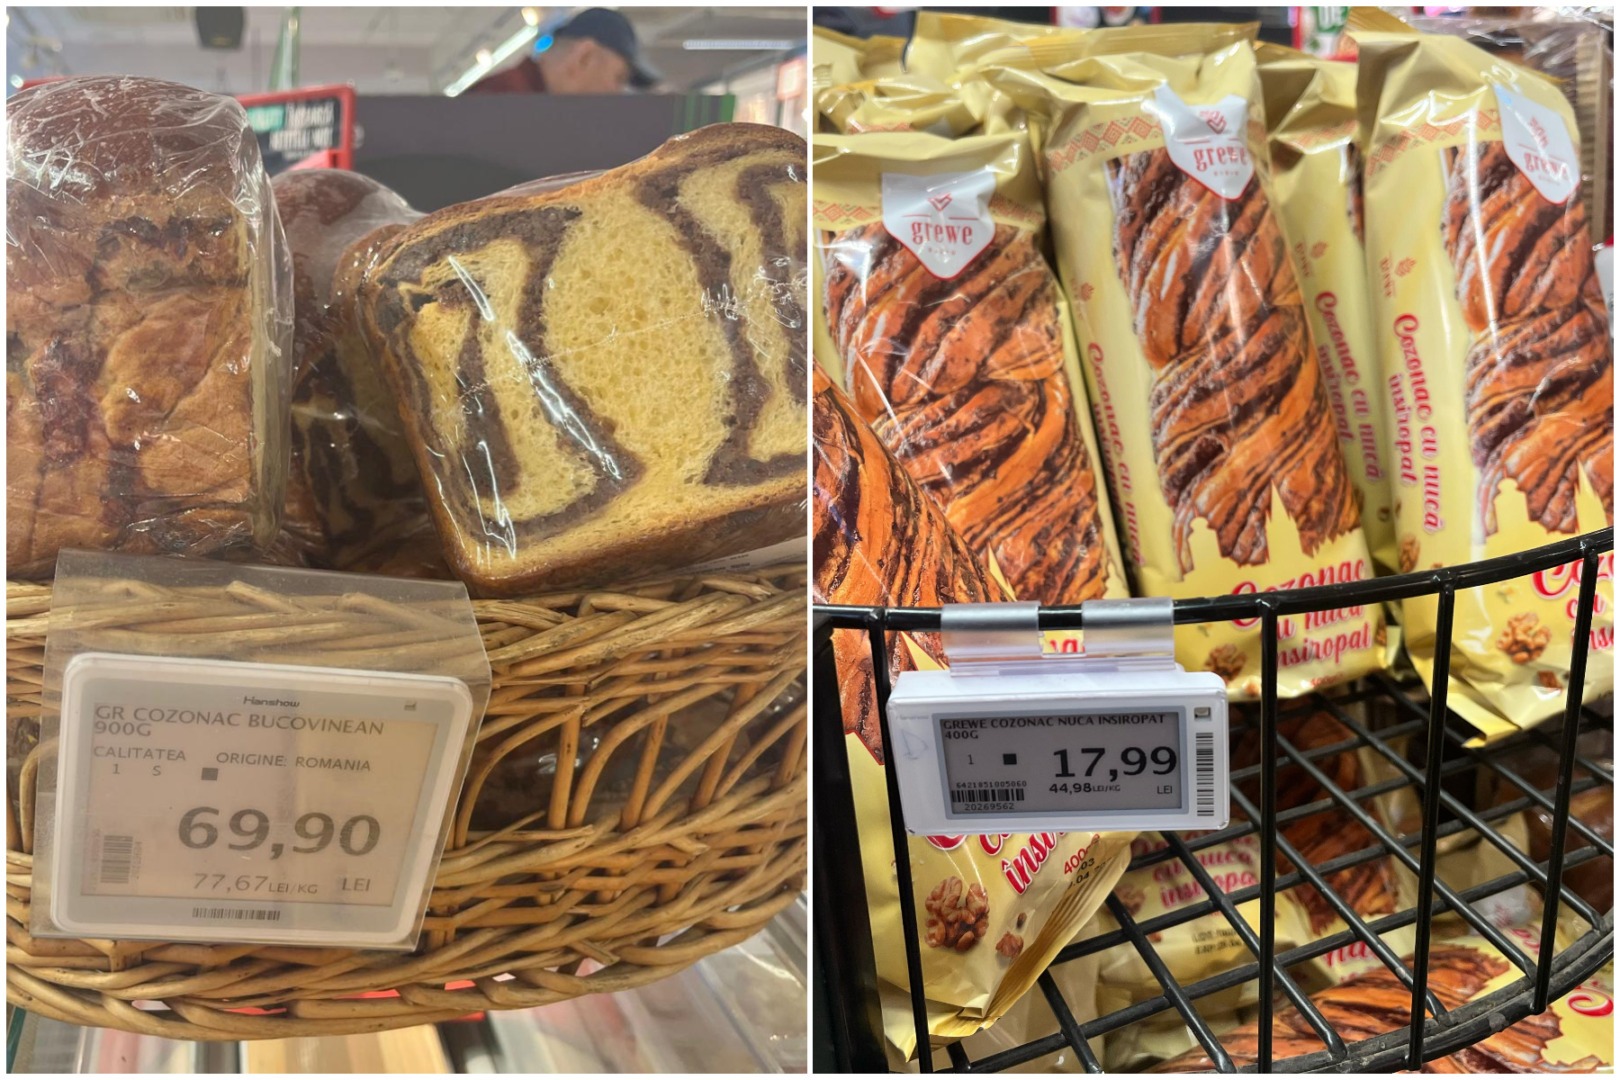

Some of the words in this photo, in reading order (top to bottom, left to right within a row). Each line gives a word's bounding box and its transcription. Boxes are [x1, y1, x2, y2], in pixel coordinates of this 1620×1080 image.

[911, 221, 973, 245] grewe
[1315, 291, 1360, 385] Cozonac
[1351, 388, 1370, 417] cu
[1394, 313, 1432, 421] Cozonac
[1421, 425, 1438, 459] cu
[1231, 559, 1364, 627] Czonac
[243, 696, 300, 707] Hanshow
[95, 705, 124, 721] GR
[133, 707, 241, 727] COZONAC
[248, 714, 384, 736] BUCOVINEAN
[943, 719, 987, 730] GREWE
[990, 717, 1054, 729] COZONAC
[1058, 716, 1095, 727] NUCA
[1098, 714, 1166, 726] INSIROPAT
[94, 721, 152, 737] 900G
[945, 730, 979, 740] 400G
[93, 746, 187, 762] CALITATEA
[216, 752, 288, 767] ORIGINE:
[295, 756, 371, 772] ROMANIA
[967, 754, 974, 765] 1
[112, 763, 121, 775] 1
[152, 765, 161, 776] S
[1053, 746, 1178, 782] 17,99
[1157, 785, 1173, 795] LEI
[965, 803, 1014, 811] 20269562
[178, 806, 381, 860] 69,90
[342, 877, 371, 892] LEI
